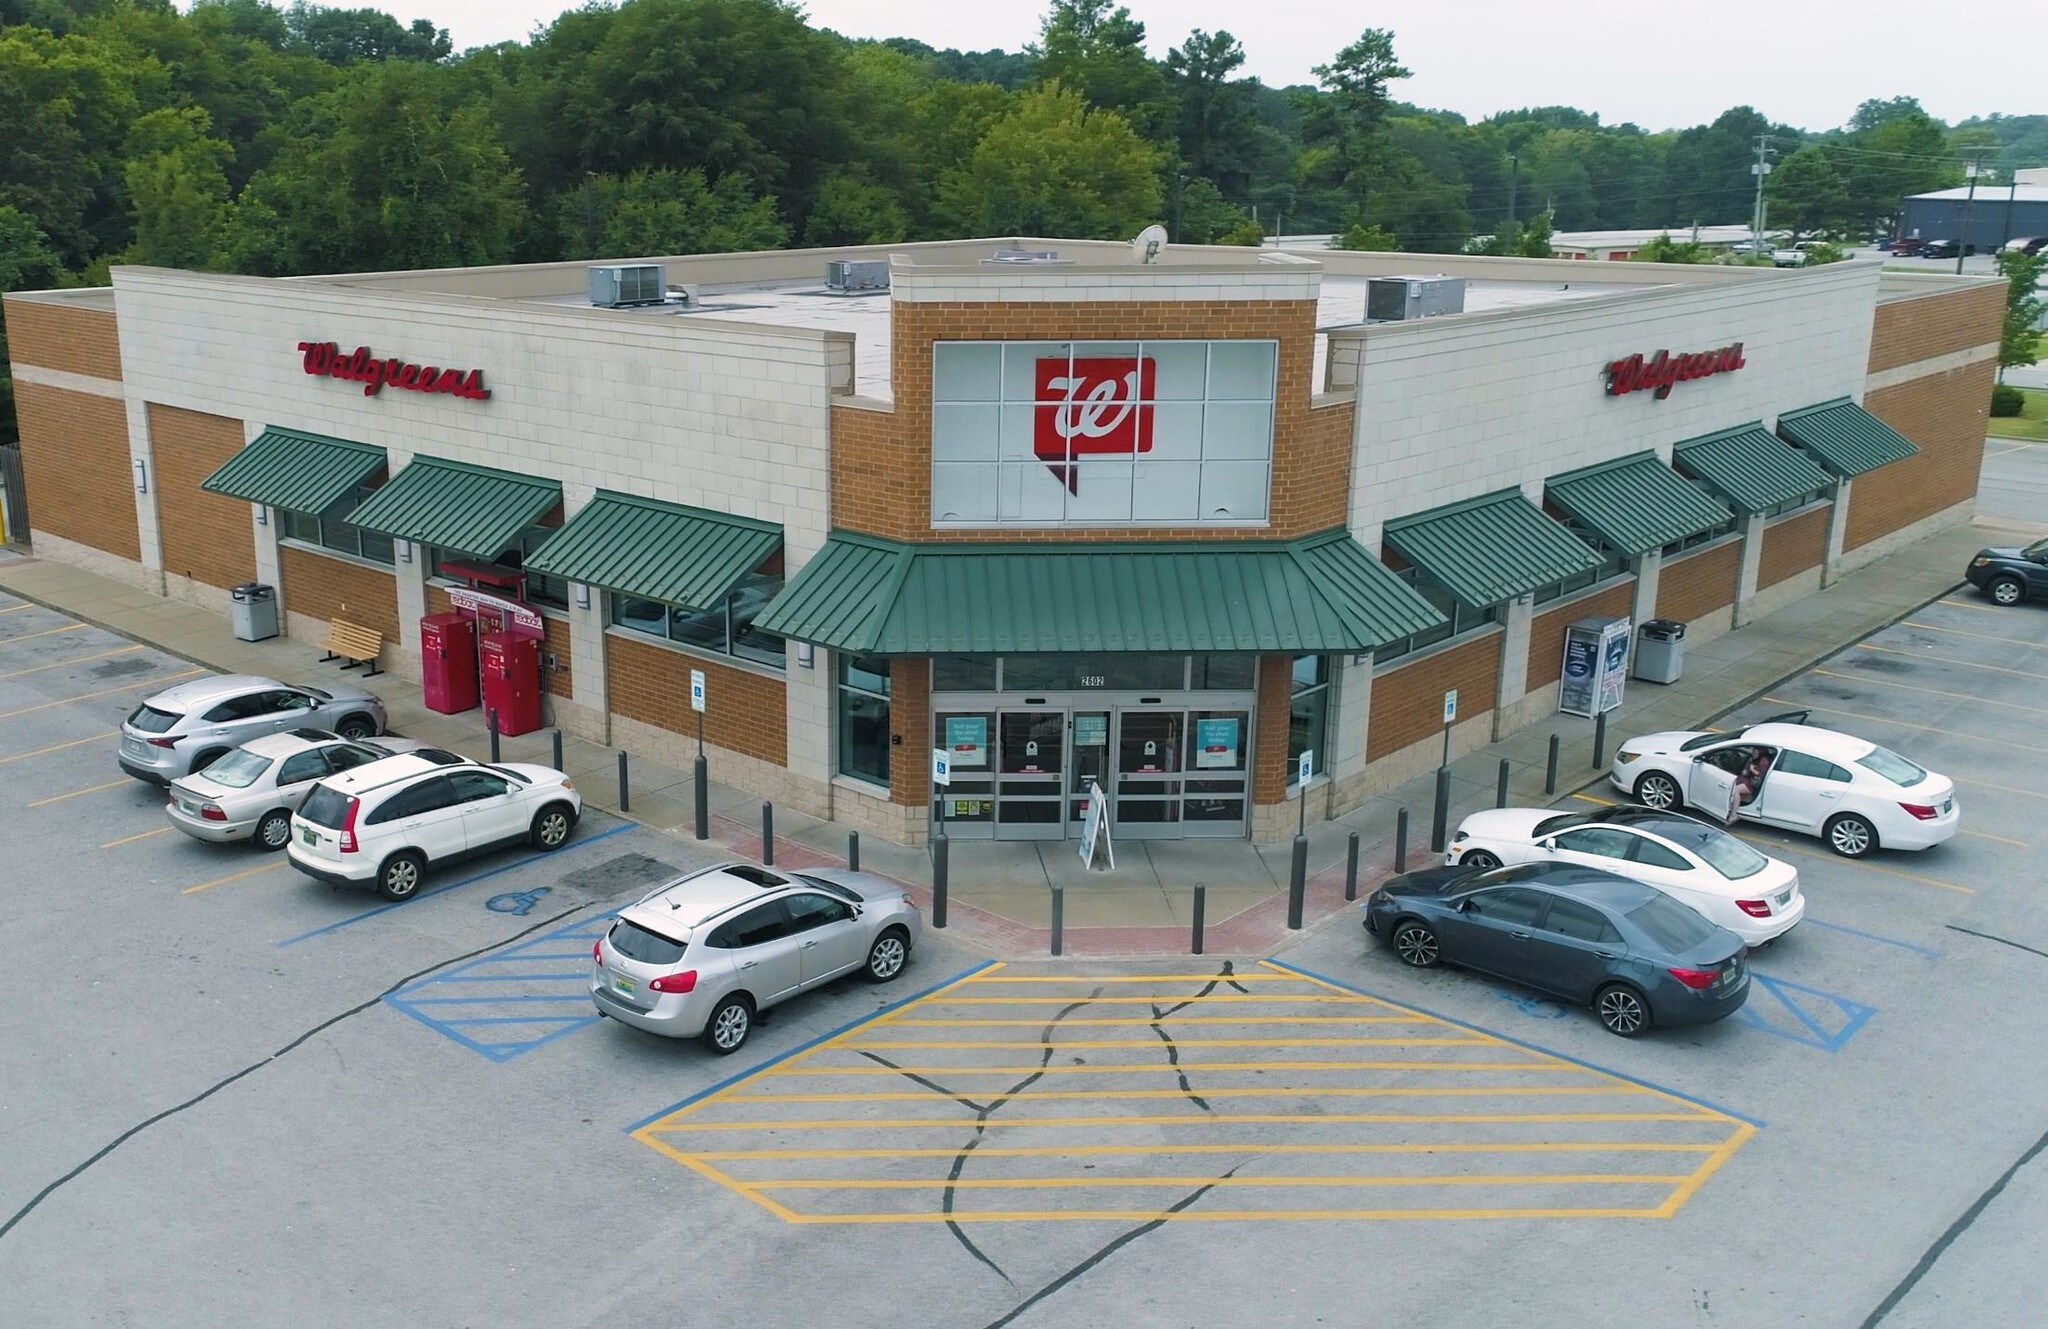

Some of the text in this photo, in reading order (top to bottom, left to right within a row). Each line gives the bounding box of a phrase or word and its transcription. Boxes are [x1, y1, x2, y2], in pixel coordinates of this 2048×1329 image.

[298, 342, 491, 400] Walgreens
[1602, 342, 1746, 400] Walgreens
[1082, 676, 1104, 687] 2602
